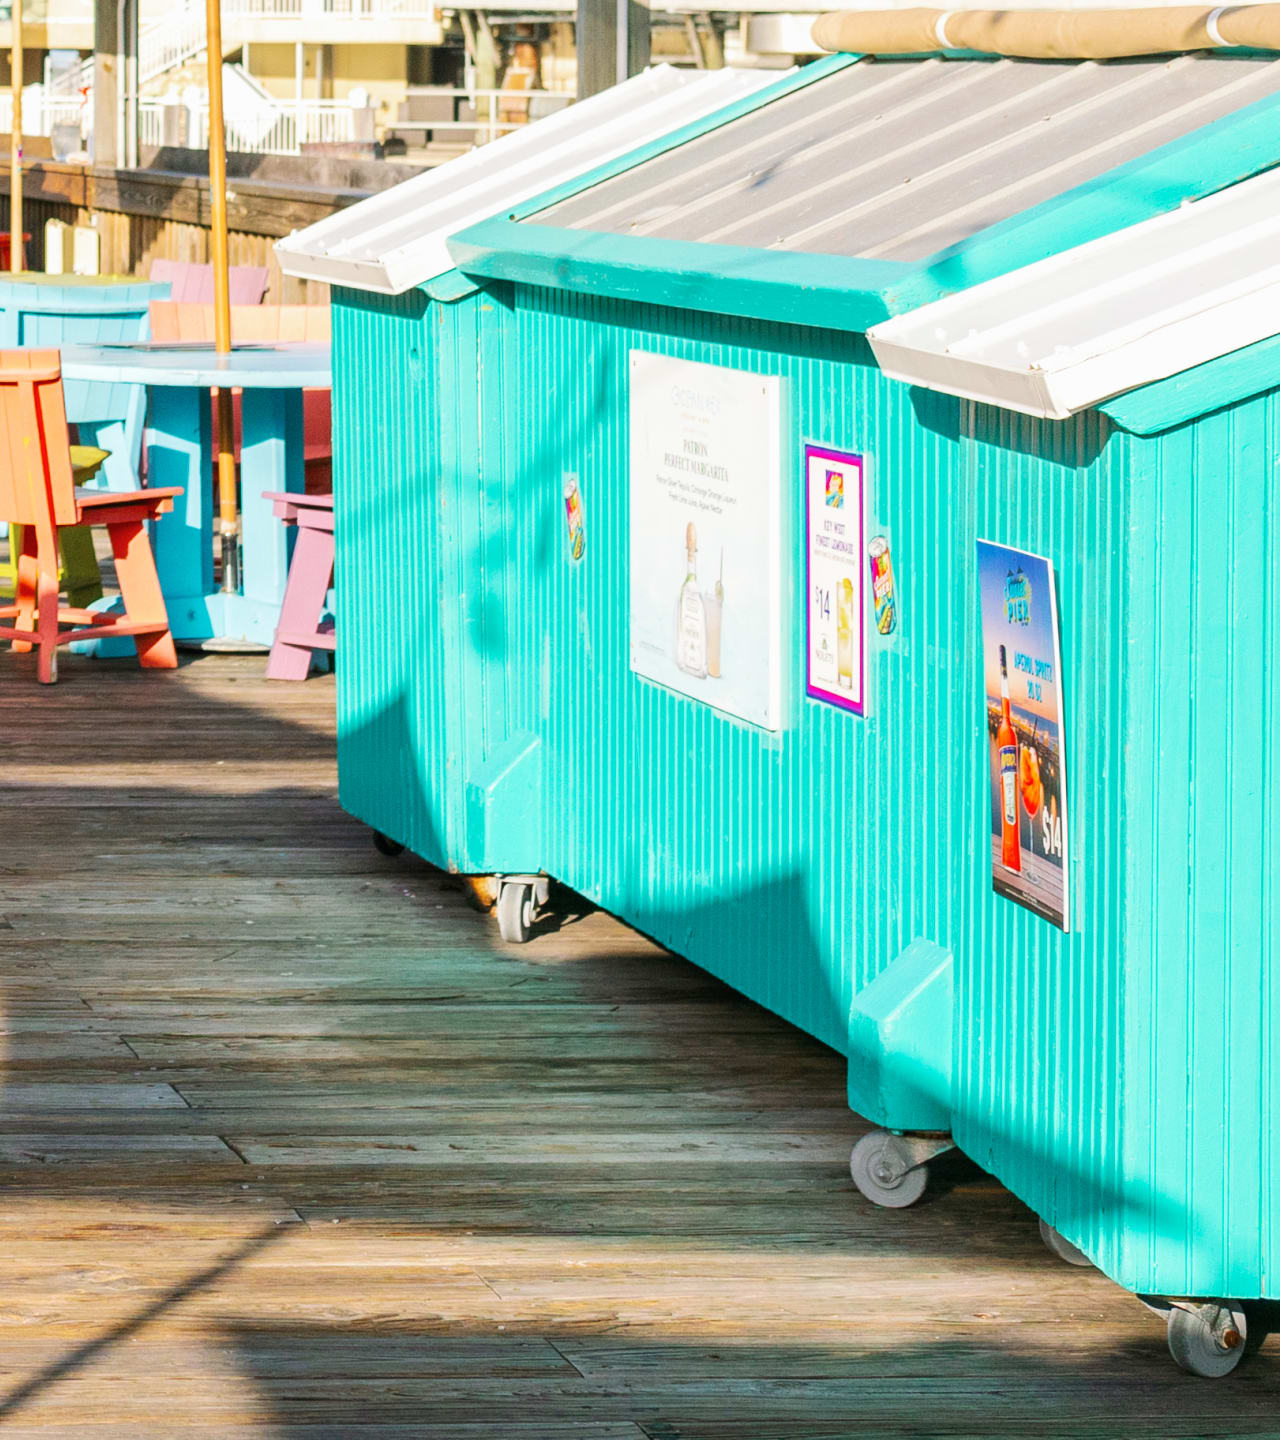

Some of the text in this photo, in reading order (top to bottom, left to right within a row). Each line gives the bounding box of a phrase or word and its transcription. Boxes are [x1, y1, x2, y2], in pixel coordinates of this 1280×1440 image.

[664, 452, 729, 482] PERFECT MARGARITA
[824, 519, 833, 532] KEY
[815, 585, 830, 621] $14
[1014, 651, 1034, 676] APEROL
[1042, 805, 1062, 858] $14
